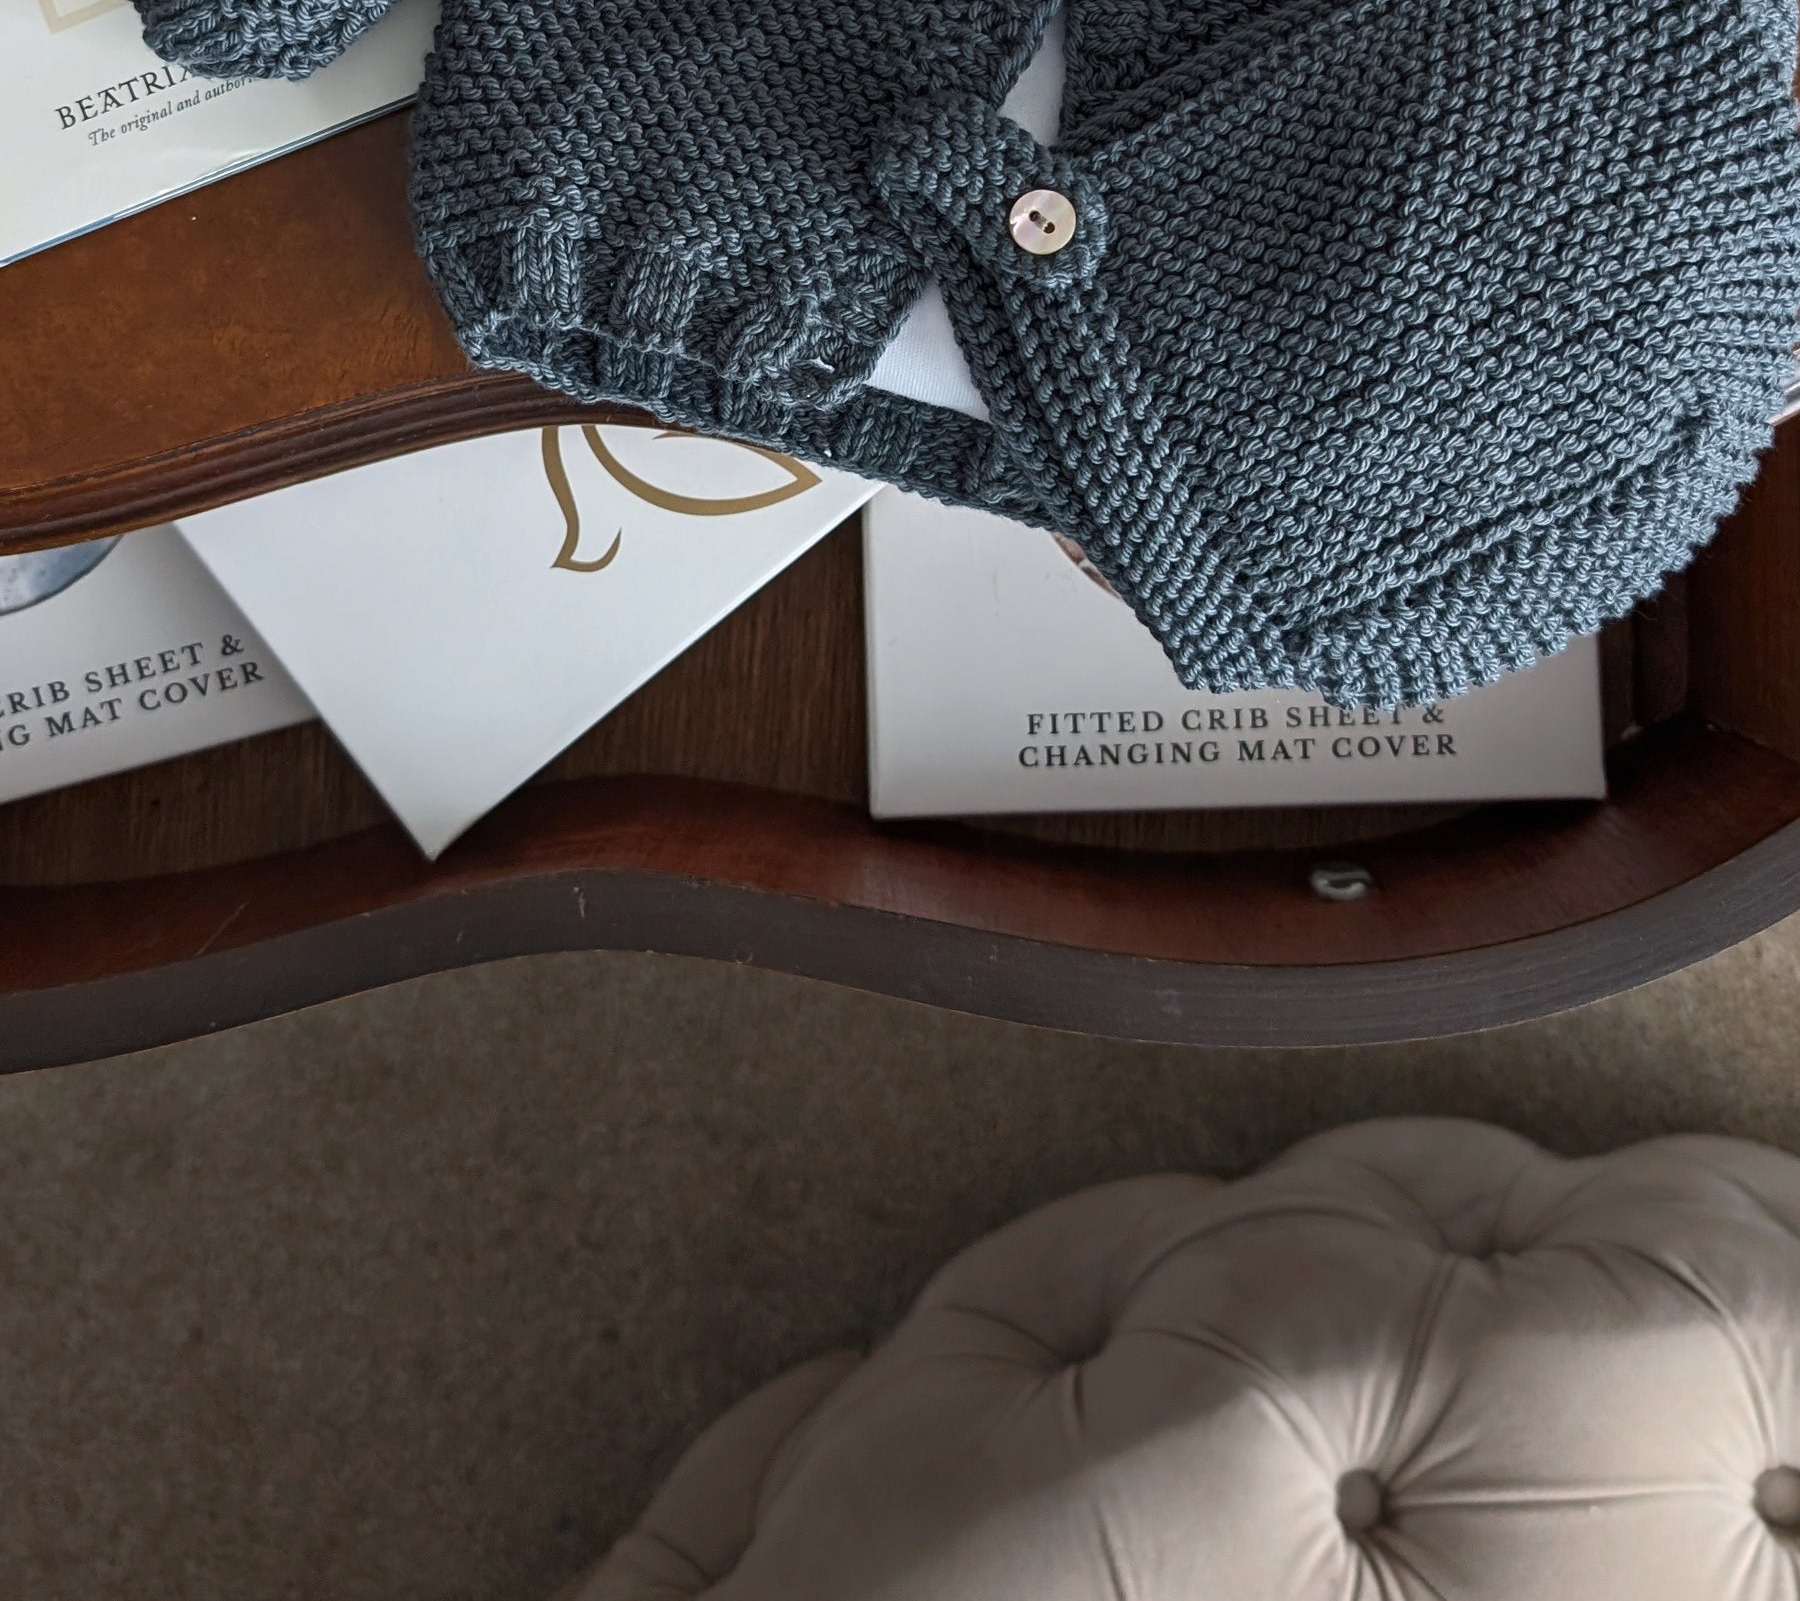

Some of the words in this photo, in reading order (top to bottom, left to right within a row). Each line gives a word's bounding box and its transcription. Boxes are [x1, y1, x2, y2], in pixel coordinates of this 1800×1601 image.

[88, 128, 116, 147] The
[120, 101, 173, 134] original
[176, 90, 201, 112] and
[0, 681, 70, 717] RIB
[84, 643, 203, 693] SHEET
[221, 634, 244, 656] &
[45, 698, 122, 738] MAT
[139, 661, 264, 711] COVER
[1027, 710, 1165, 735] FITTED
[1181, 706, 1269, 731] CRIB
[1422, 704, 1445, 724] &
[1018, 741, 1220, 767] CHANGING
[1237, 737, 1316, 761] MAT
[1331, 733, 1457, 758] COVER
